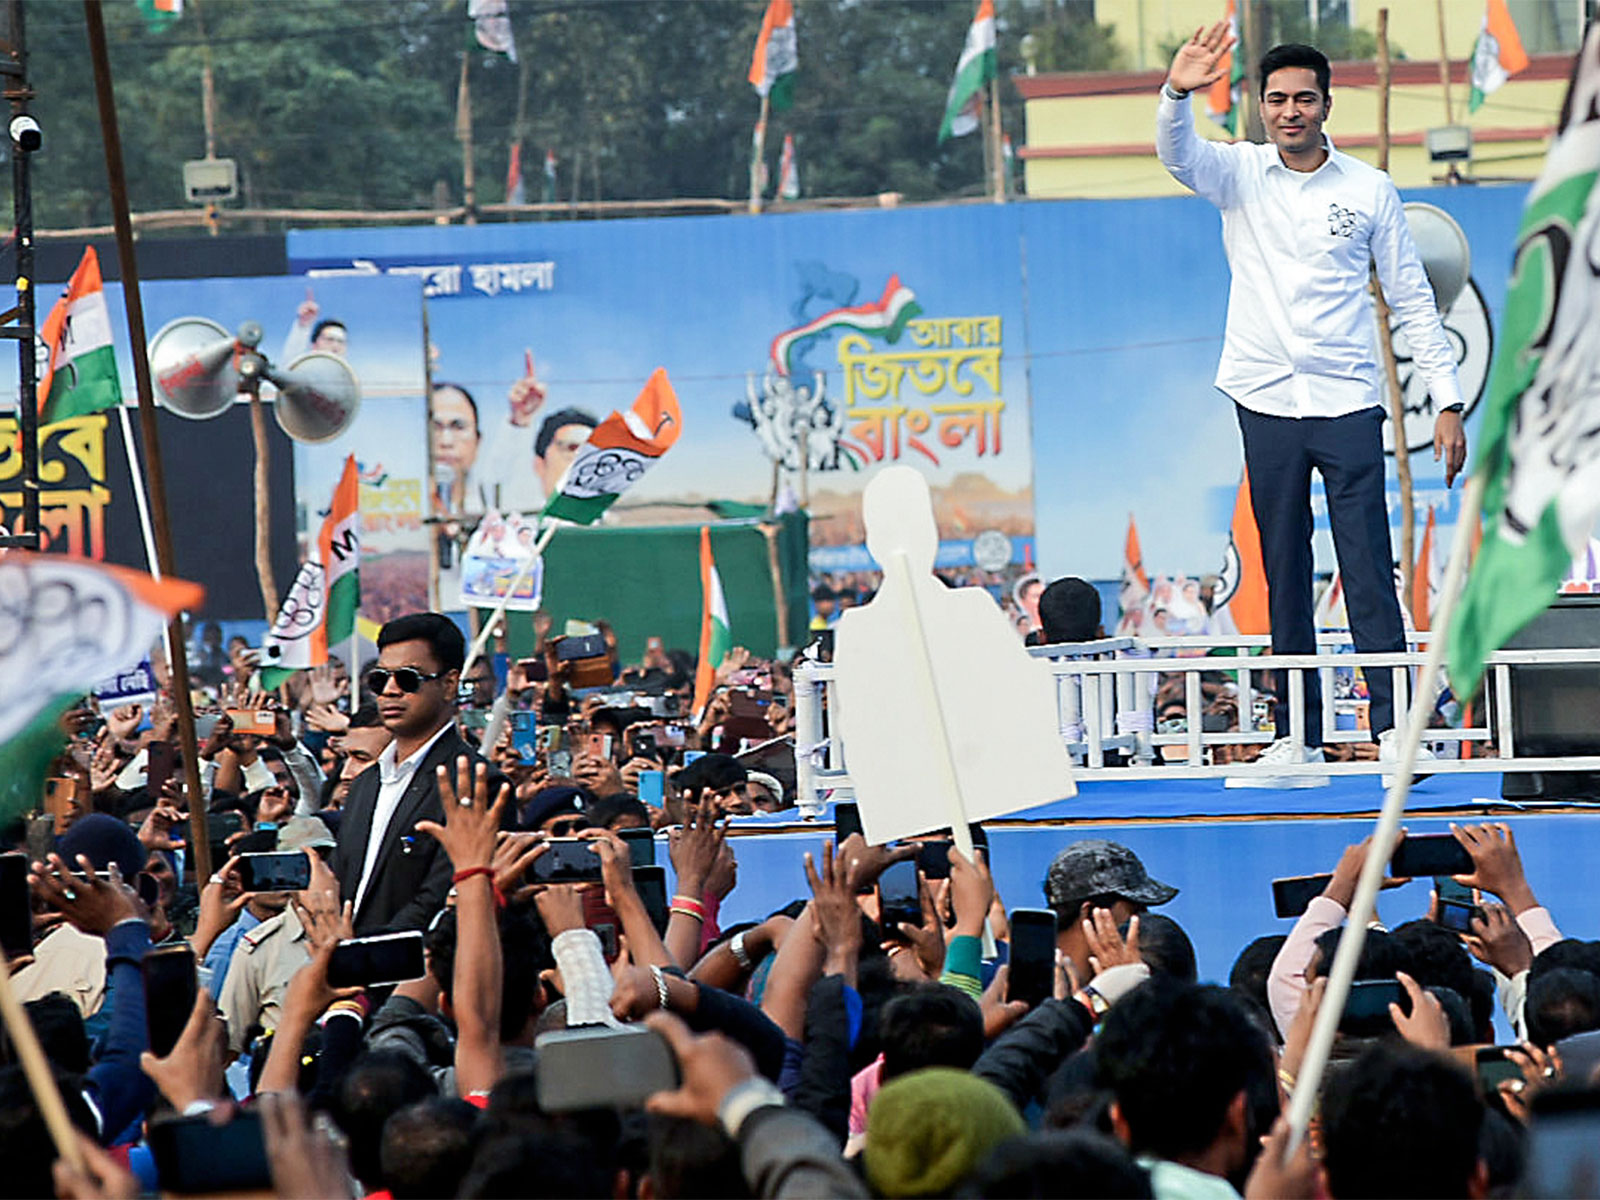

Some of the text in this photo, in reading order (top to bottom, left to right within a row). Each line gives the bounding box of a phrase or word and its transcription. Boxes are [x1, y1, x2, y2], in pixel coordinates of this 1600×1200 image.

[468, 262, 555, 296] হামলা
[907, 316, 1002, 347] আবার
[838, 334, 1002, 405] জিতবে
[845, 401, 1006, 466] বাংলা
